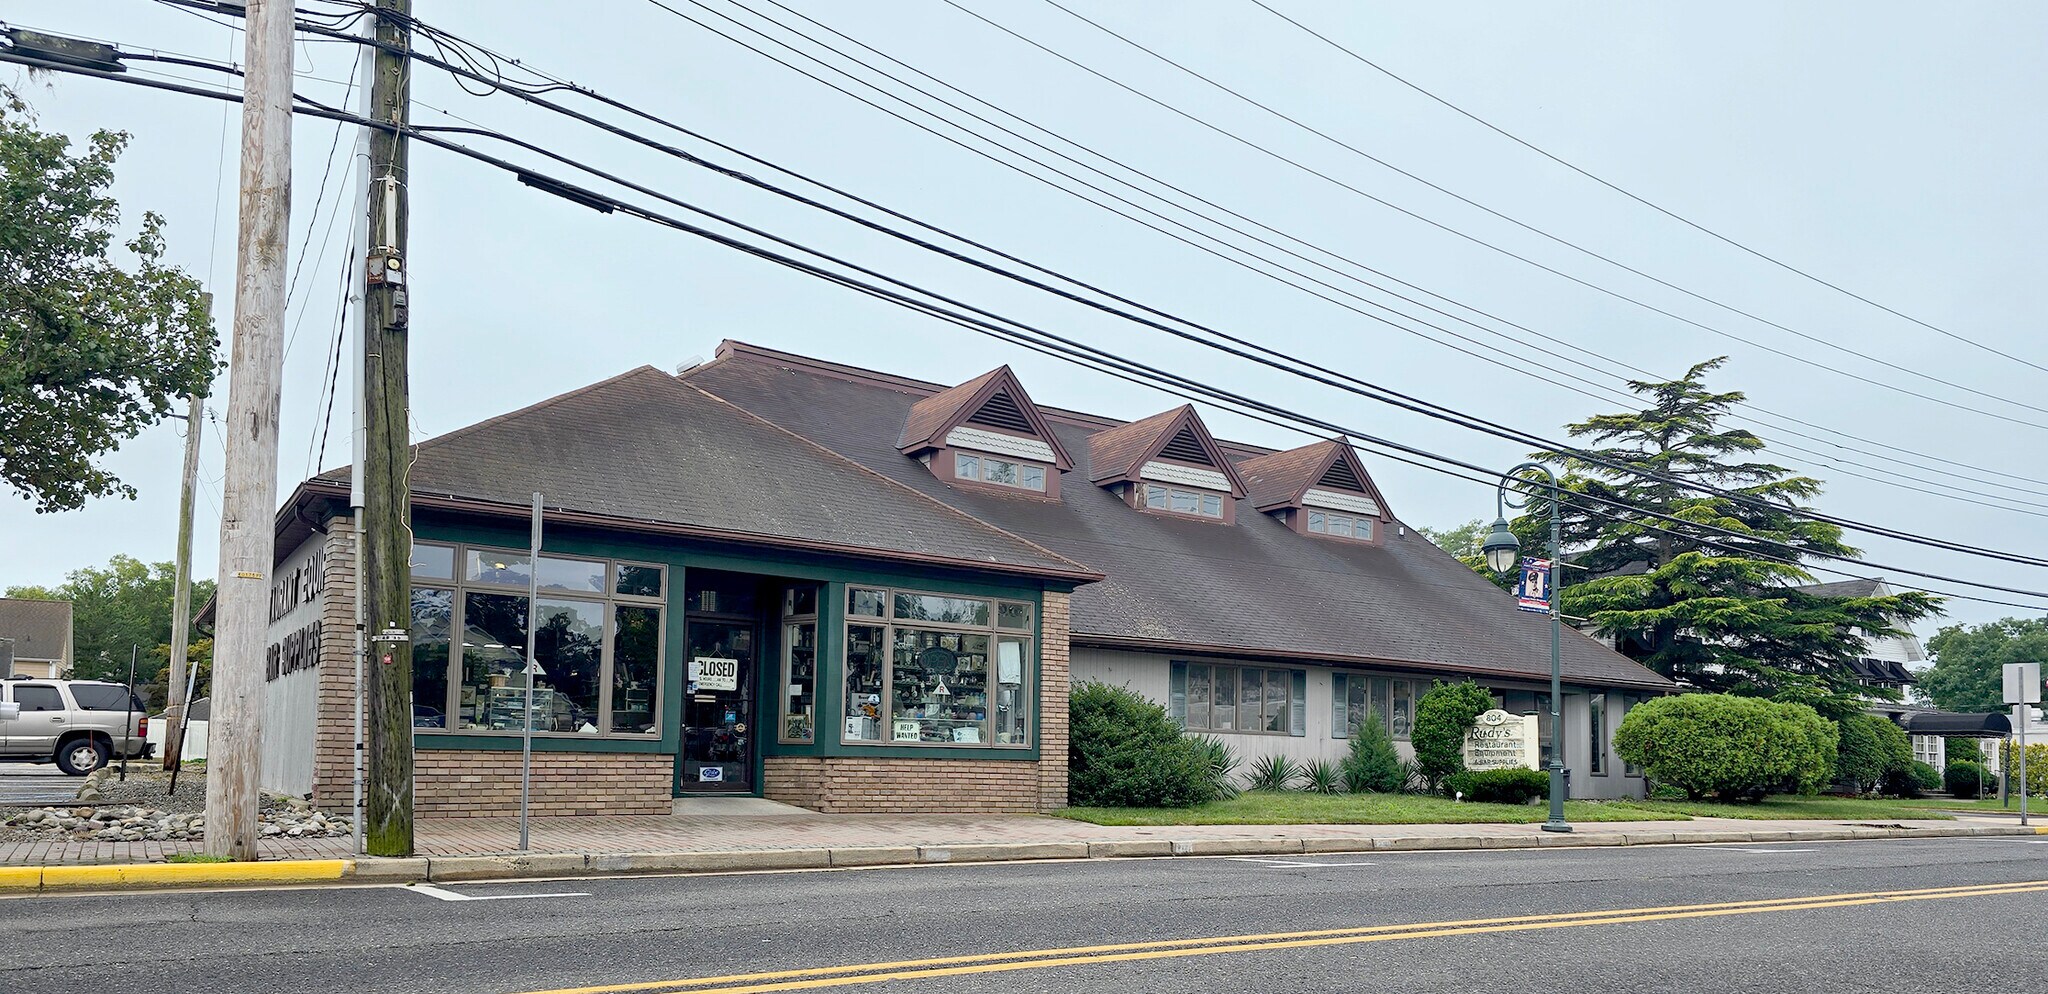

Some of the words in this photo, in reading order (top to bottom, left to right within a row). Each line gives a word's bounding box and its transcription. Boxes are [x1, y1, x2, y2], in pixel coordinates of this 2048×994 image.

[282, 619, 321, 676] SUPPLIES
[1486, 714, 1502, 722] 804
[1468, 726, 1511, 740] Rudy's
[1474, 741, 1517, 749] Restaurant
[1474, 749, 1516, 757] Equipment
